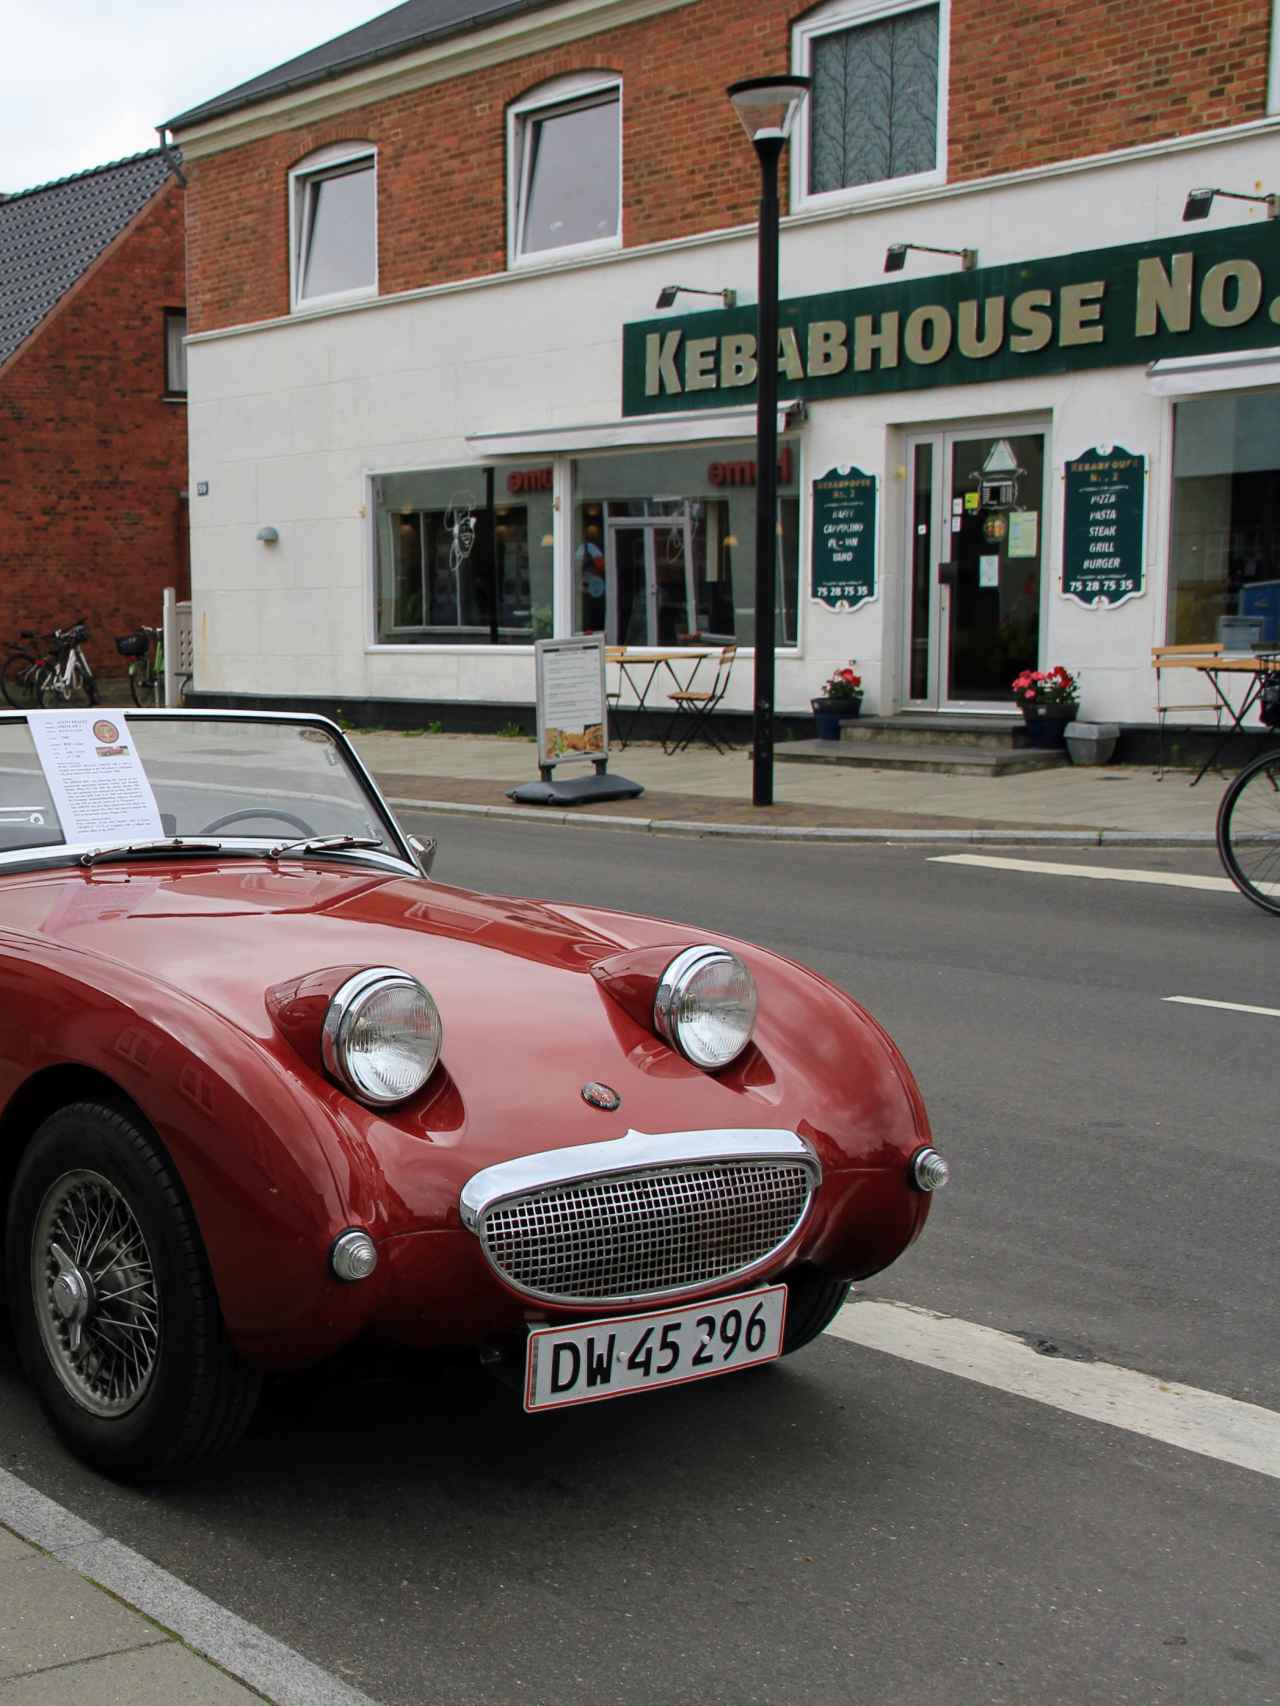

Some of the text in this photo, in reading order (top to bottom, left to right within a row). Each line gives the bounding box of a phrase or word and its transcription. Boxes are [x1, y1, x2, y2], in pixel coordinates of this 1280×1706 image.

[645, 280, 1106, 397] KEBABHOUSE
[1090, 494, 1116, 505] PIZZA
[1089, 509, 1117, 521] PASTA
[1089, 526, 1116, 537] STEAK
[1089, 542, 1115, 553] GRILL
[1083, 557, 1121, 570] BURGER
[817, 586, 828, 597] 75
[844, 586, 855, 596] 75
[1069, 579, 1133, 592] 75 28 75 35
[549, 1300, 767, 1394] DW 45 296
